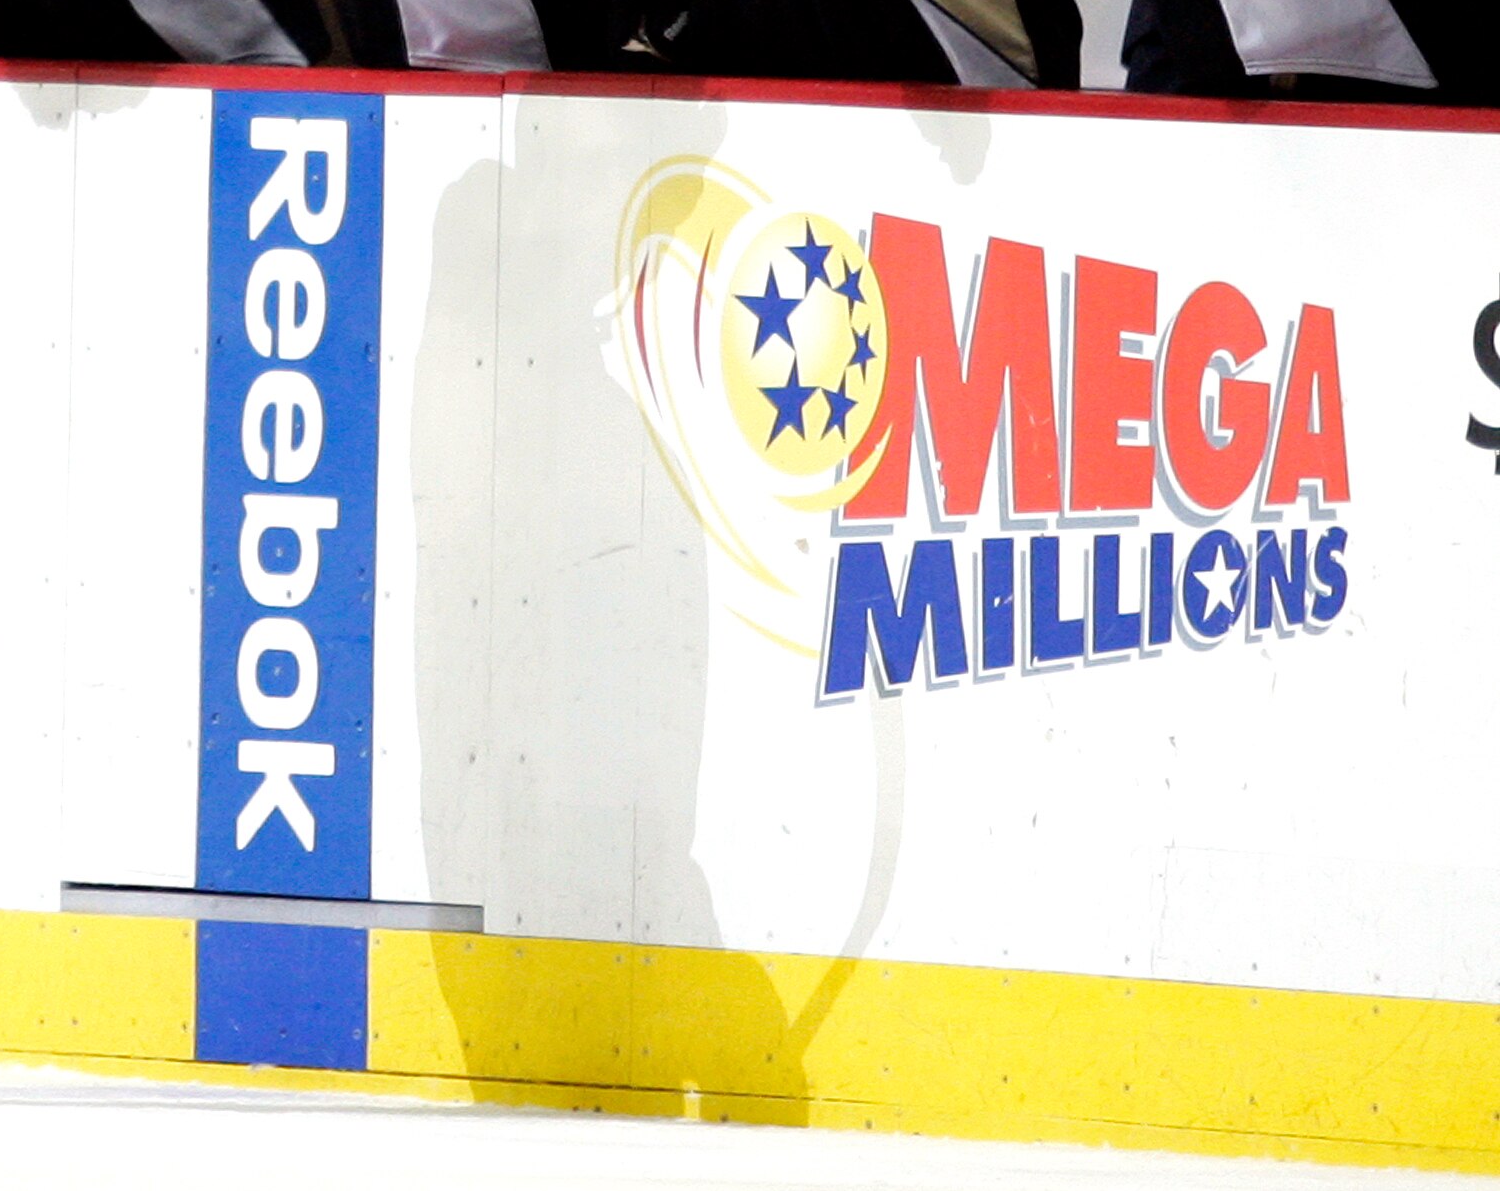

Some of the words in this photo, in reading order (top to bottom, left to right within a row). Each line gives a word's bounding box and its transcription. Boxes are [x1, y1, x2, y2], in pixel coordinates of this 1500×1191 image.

[235, 116, 349, 852] Reebok
[835, 211, 1351, 528] MEGA
[817, 526, 1349, 703] MILLIONS
